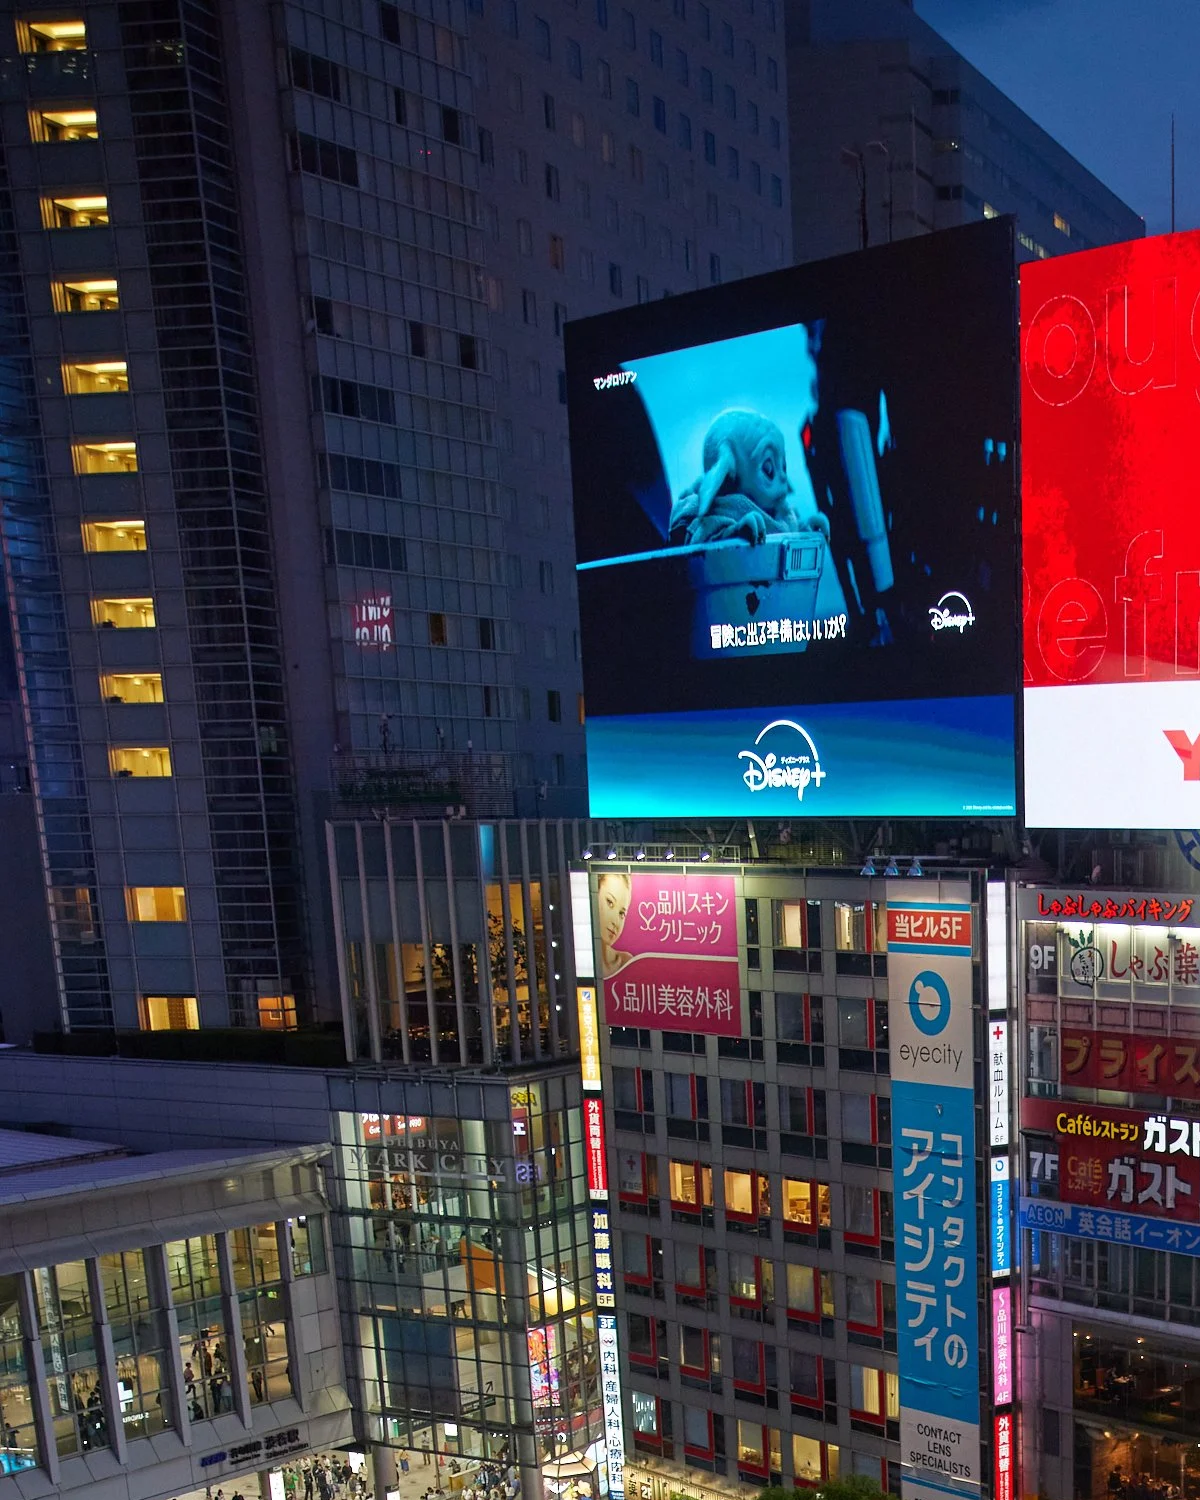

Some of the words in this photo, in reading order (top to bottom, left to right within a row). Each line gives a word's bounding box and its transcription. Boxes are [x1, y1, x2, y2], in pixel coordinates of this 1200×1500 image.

[593, 370, 638, 390] マンダロリアン
[927, 600, 976, 634] Disney+
[738, 746, 826, 801] Disney+
[657, 889, 730, 916] 品川スキン
[1037, 893, 1195, 923] しゃぶしゃぶバイキング
[658, 919, 723, 945] クリニック
[894, 913, 963, 941] 当ビル5F
[1030, 944, 1056, 971] 9F
[1110, 939, 1200, 986] しゃぶ葉
[623, 983, 734, 1021] 品川美容外科
[899, 1043, 963, 1072] eyecity
[992, 1052, 1005, 1130] 献血ルーム
[587, 1100, 601, 1151] 外貨両替
[1056, 1113, 1139, 1142] Caféレストラン
[386, 1138, 460, 1151] SHIBUYA
[350, 1148, 430, 1171] MARK
[439, 1153, 506, 1176] CITY
[1029, 1151, 1059, 1181] 7F
[1067, 1155, 1103, 1179] Café
[1107, 1156, 1192, 1210] ガスト
[1027, 1205, 1065, 1228] AEON
[1078, 1210, 1200, 1250] 英会話イーオン
[592, 1211, 613, 1291] 加藤眼科
[900, 1127, 936, 1364] アイシティ
[940, 1132, 969, 1369] コンタクトの
[598, 1294, 613, 1306] 5F
[600, 1318, 615, 1329] 3F
[996, 1308, 1008, 1387] 品川美容外科
[603, 1351, 617, 1375] 内科
[996, 1391, 1009, 1403] 4F
[916, 1422, 962, 1445] CONTACT
[998, 1416, 1011, 1473] 外貨両替
[927, 1440, 952, 1458] LENS
[909, 1450, 971, 1478] SPECIALISTS
[640, 1484, 652, 1500] 2F
